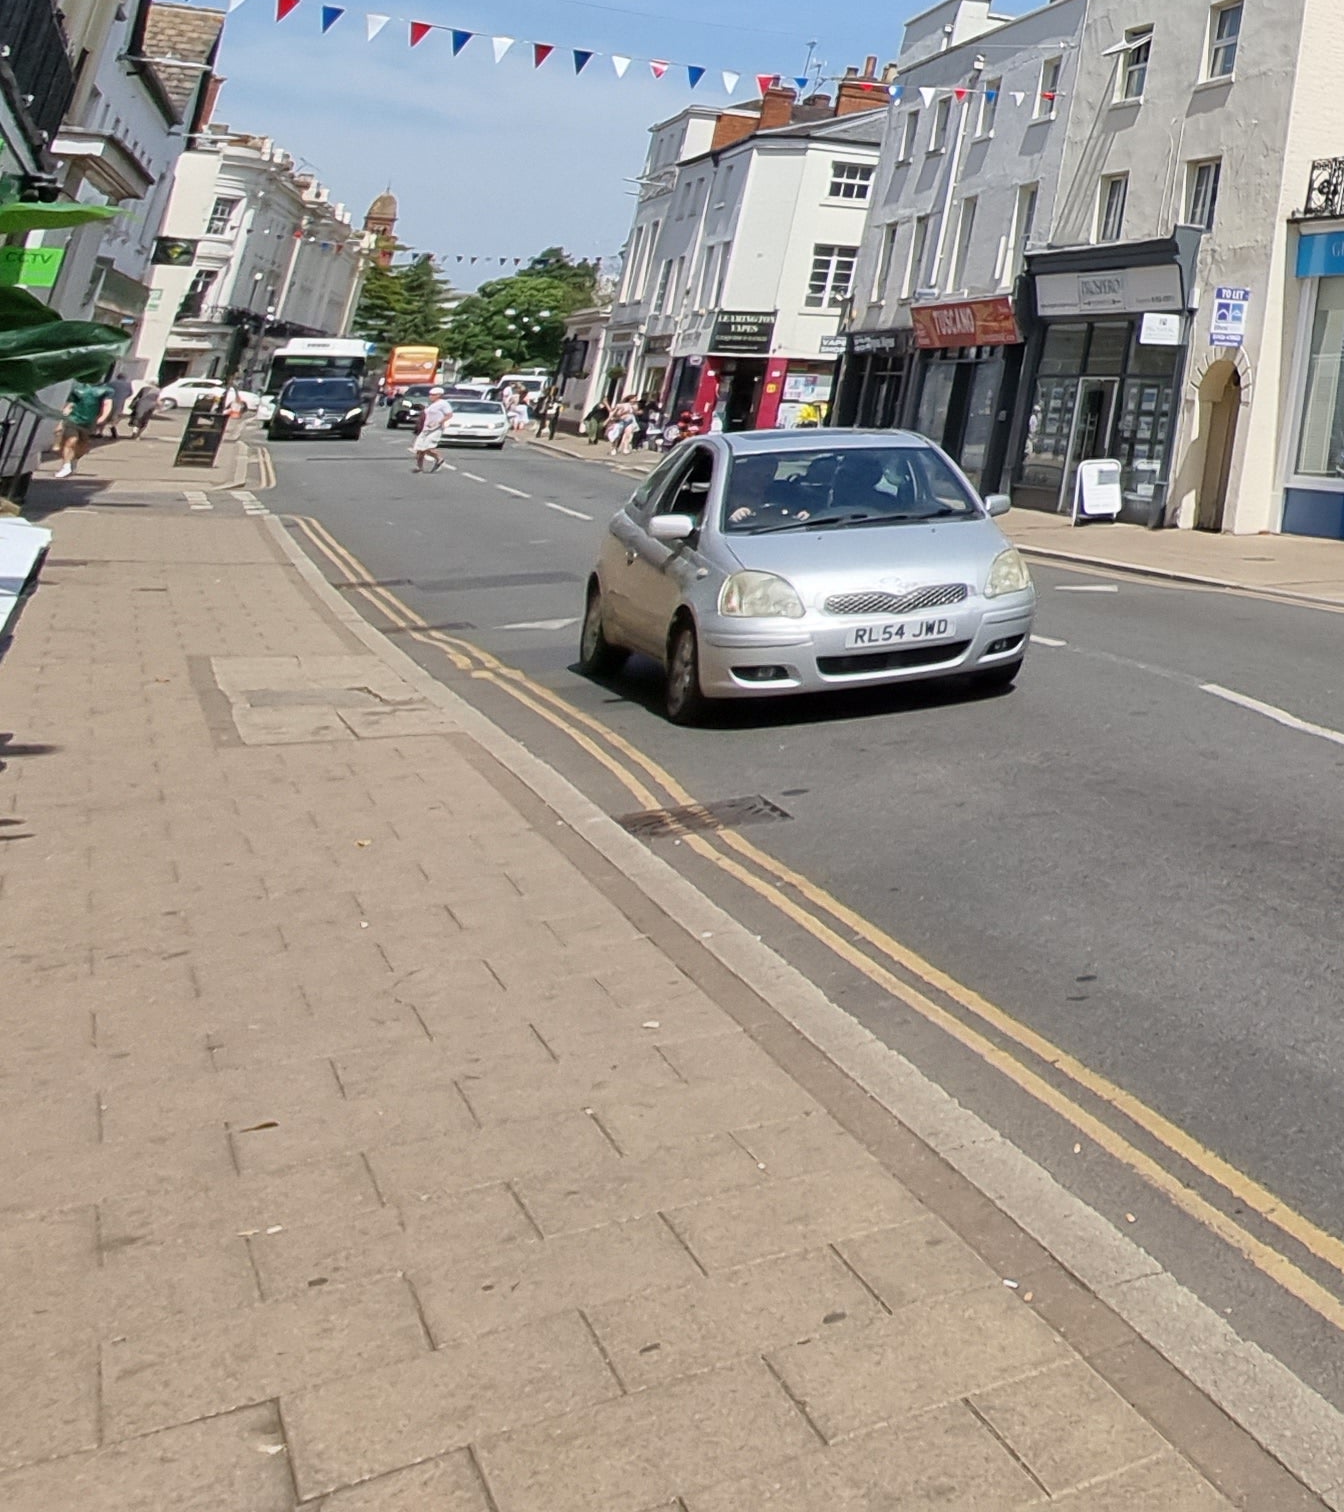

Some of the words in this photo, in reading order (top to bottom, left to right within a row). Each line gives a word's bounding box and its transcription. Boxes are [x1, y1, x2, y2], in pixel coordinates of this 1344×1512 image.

[6, 251, 52, 265] CCTV
[1222, 290, 1232, 298] TO
[1233, 290, 1244, 300] LET
[730, 324, 759, 333] VAPES
[854, 624, 906, 645] RL54
[912, 619, 949, 638] JWD
